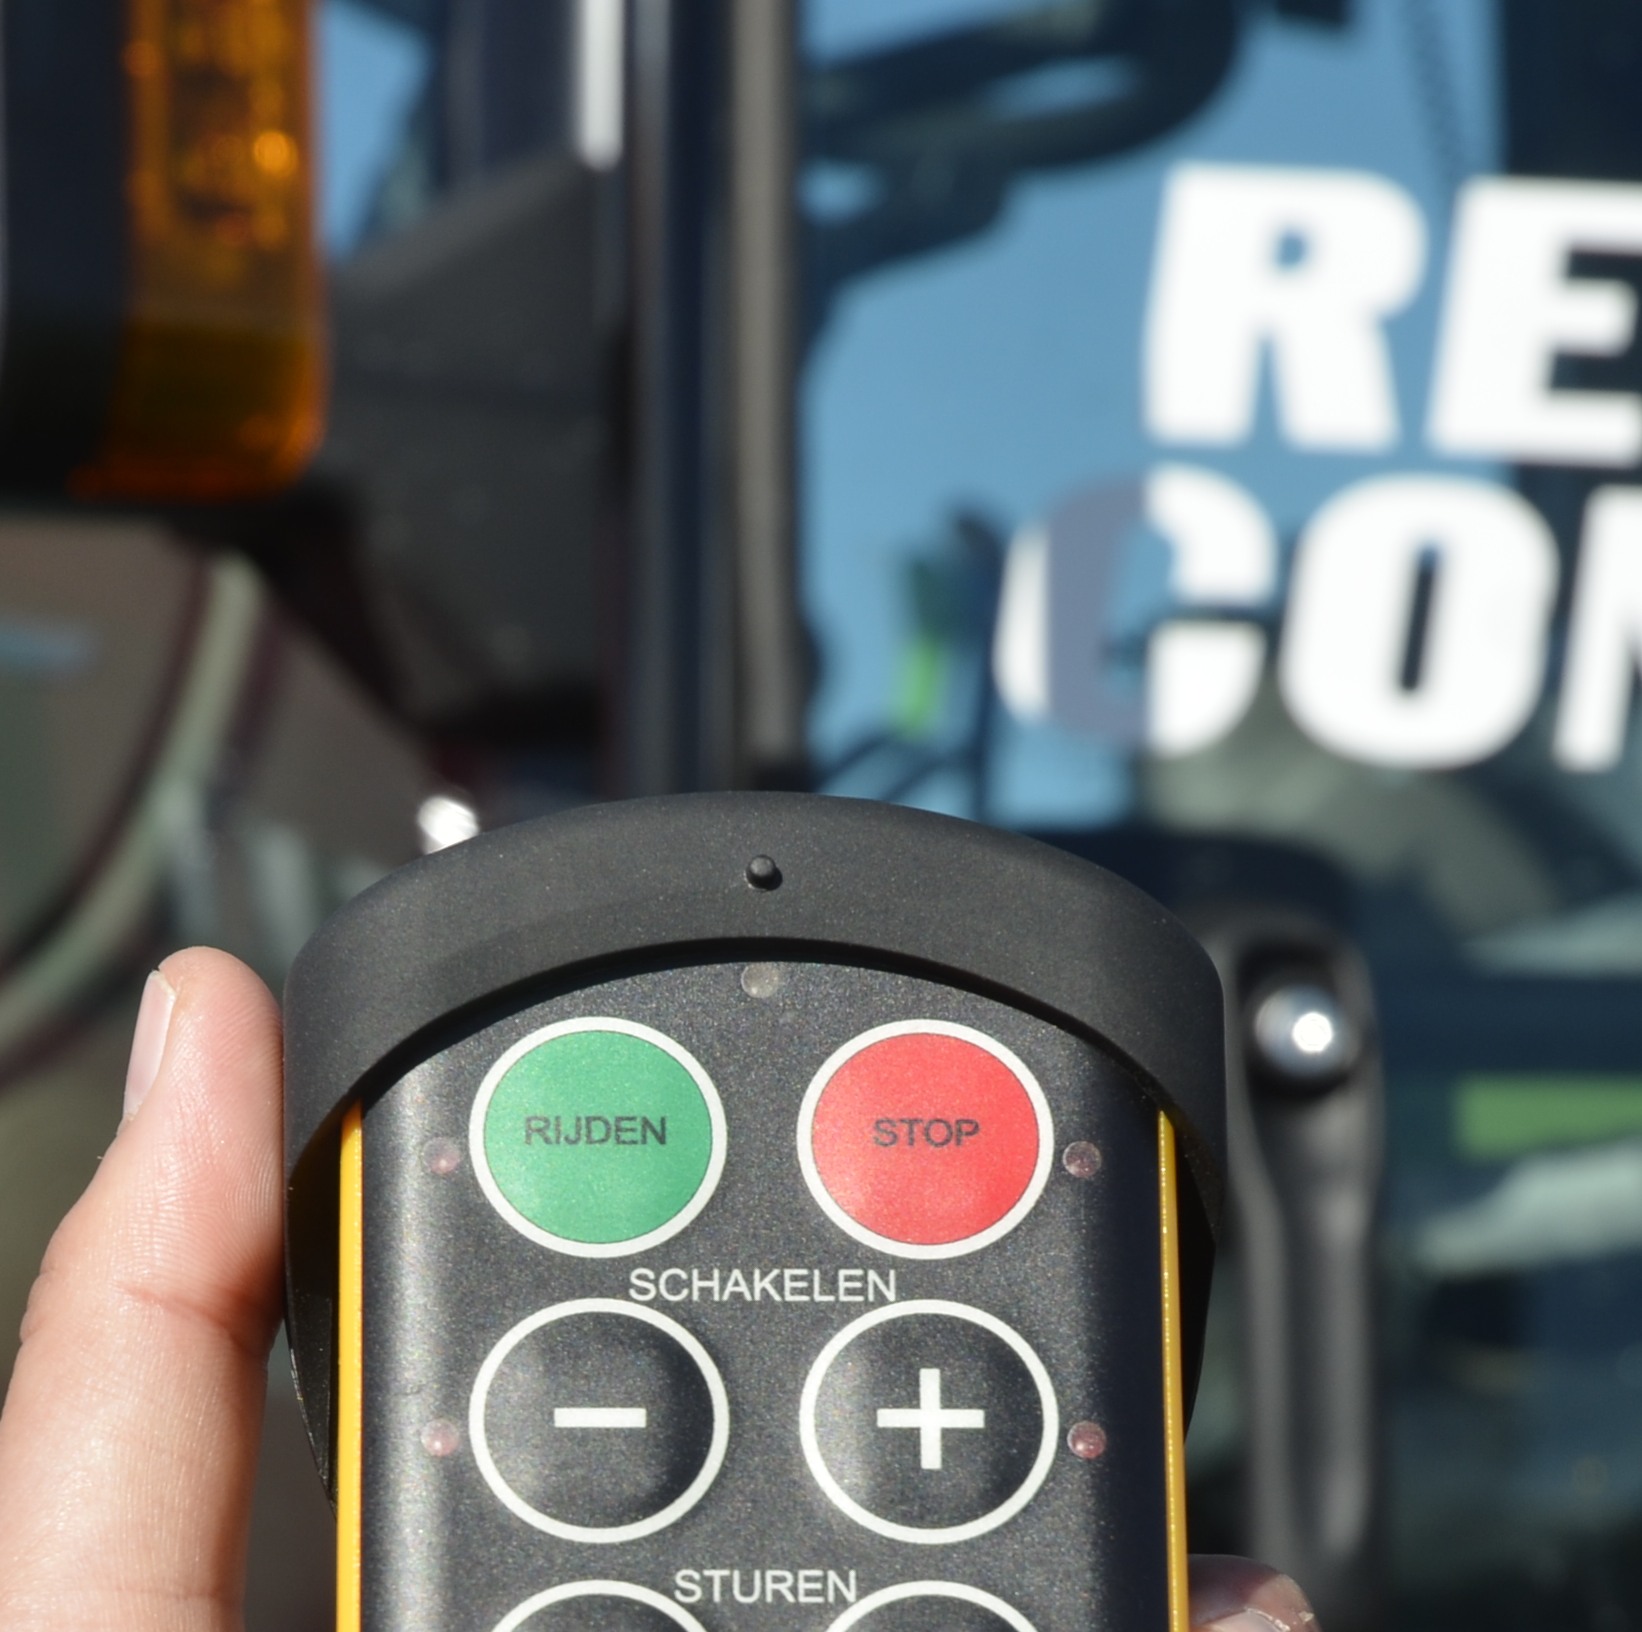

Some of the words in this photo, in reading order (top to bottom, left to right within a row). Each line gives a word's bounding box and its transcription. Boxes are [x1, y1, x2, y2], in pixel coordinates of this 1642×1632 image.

[523, 1114, 668, 1147] RIJDEN
[872, 1116, 981, 1149] STOP
[628, 1267, 897, 1303] SCHAKELEN
[673, 1568, 858, 1603] STUREN
